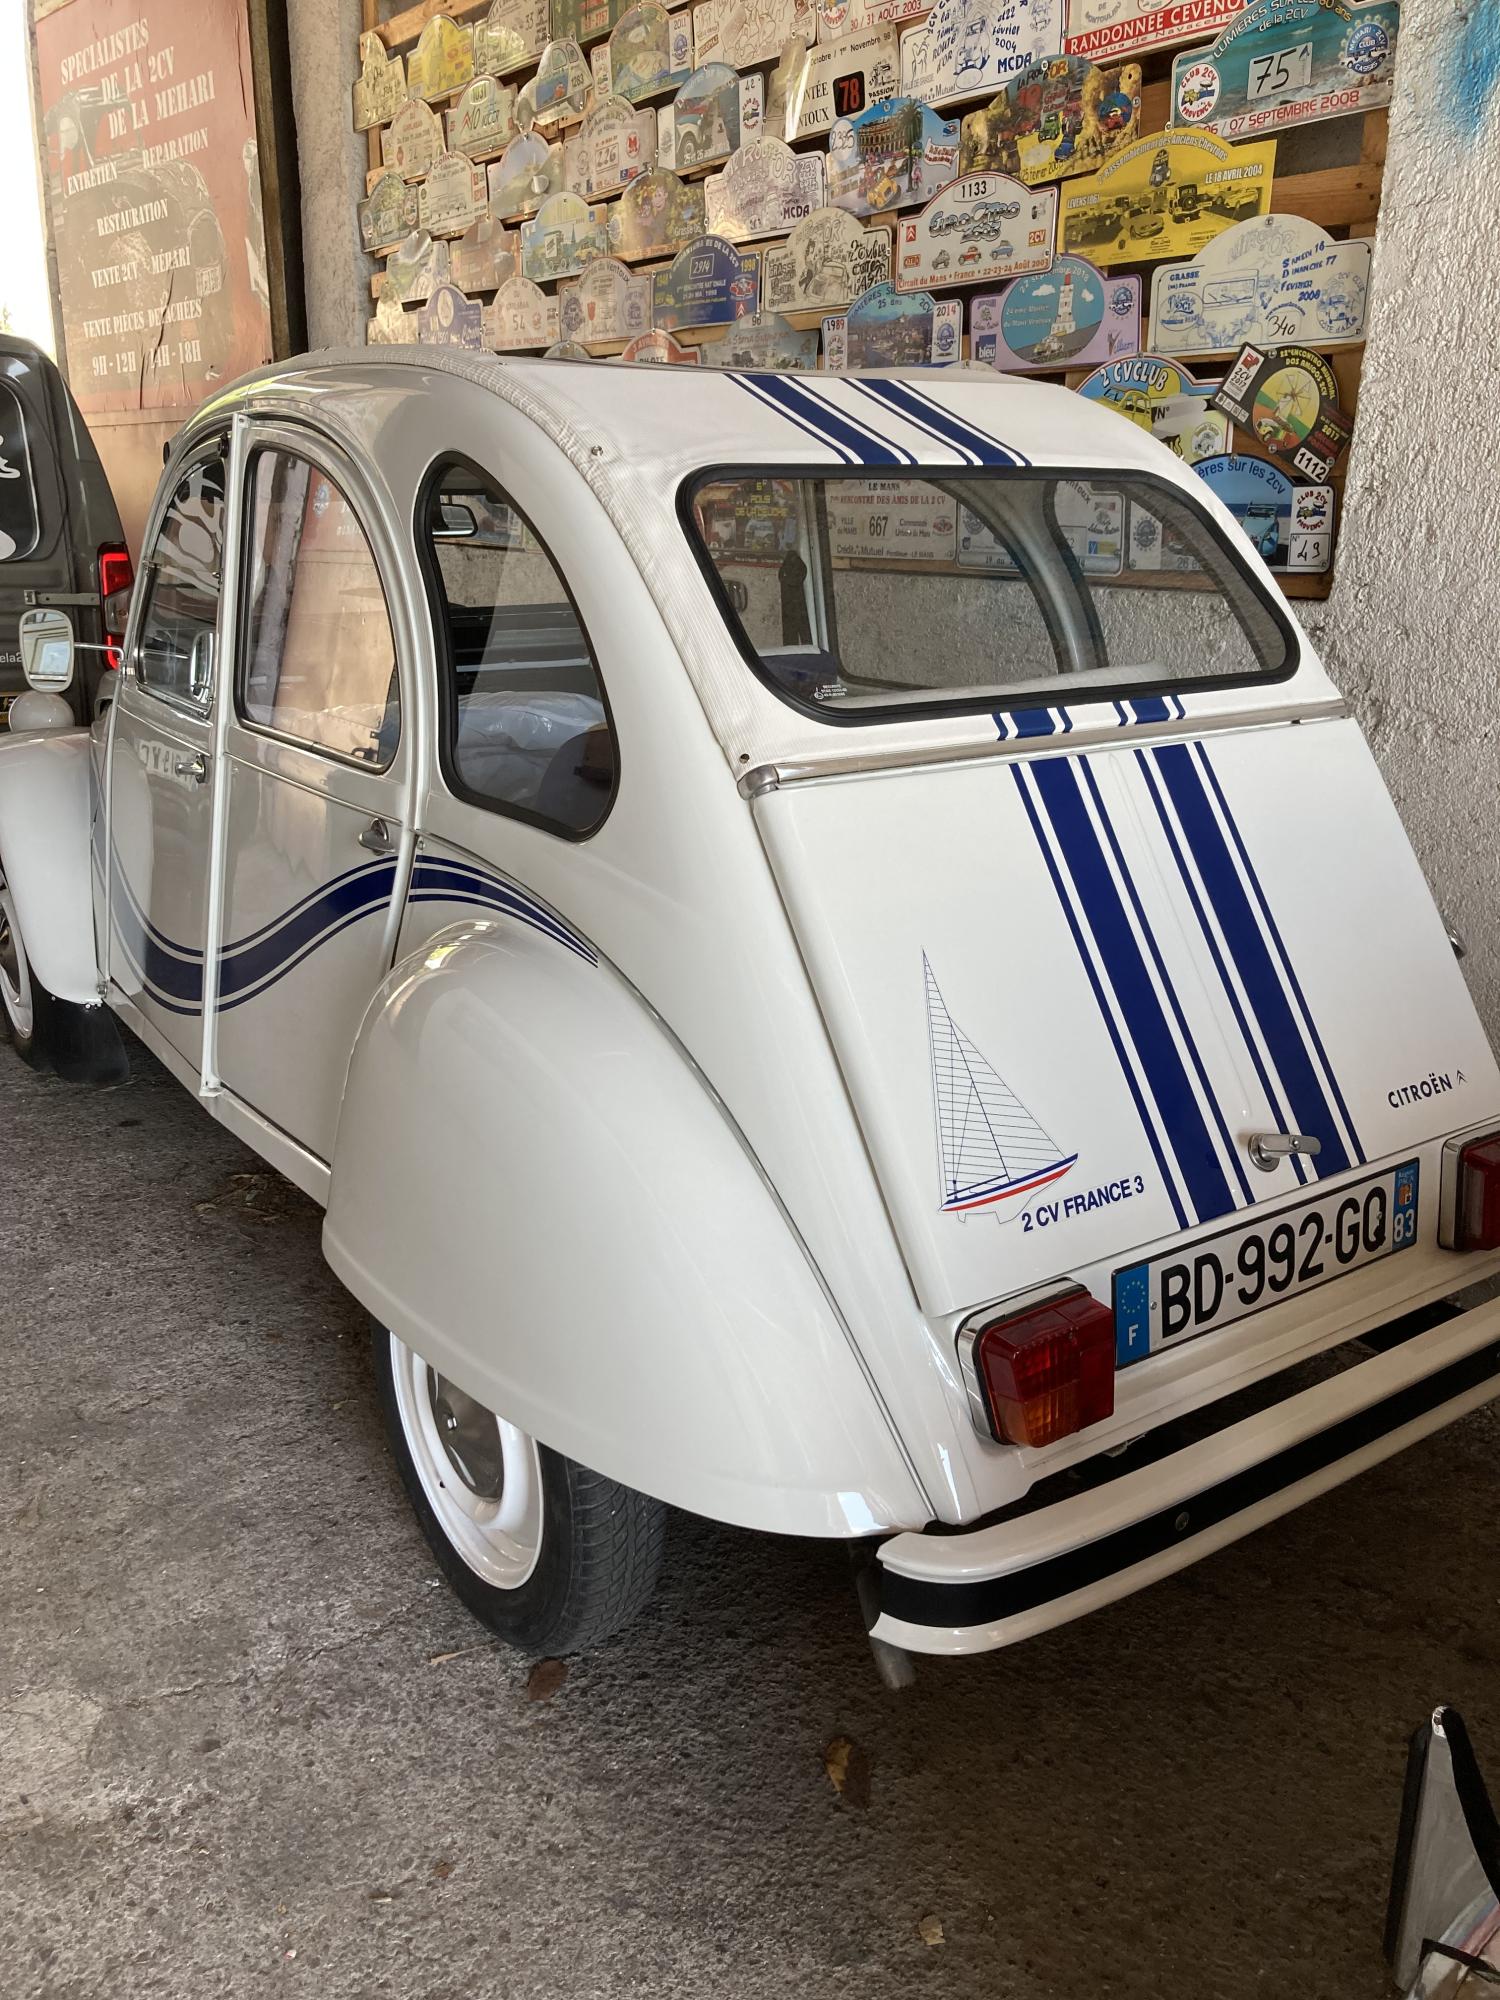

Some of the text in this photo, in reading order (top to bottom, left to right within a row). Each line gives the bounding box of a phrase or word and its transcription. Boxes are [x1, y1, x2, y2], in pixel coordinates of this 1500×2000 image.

[867, 14, 874, 25] 31
[878, 3, 899, 21] AOÛT
[903, 1, 921, 13] 2003
[1259, 8, 1310, 32] de la 2CV
[1070, 0, 1244, 54] RANDONNEE CEVENO
[1213, 8, 1268, 58] LUMIERES
[1335, 4, 1352, 22] ans
[60, 18, 149, 85] SPECIALISTES
[850, 35, 881, 52] Novembre
[995, 37, 1017, 53] 2004
[1358, 38, 1376, 48] CLUB
[997, 52, 1032, 74] MCDA
[101, 46, 174, 104] DE LA 2CV
[1181, 66, 1217, 88] CLUB 2CV
[839, 78, 860, 112] 78
[868, 85, 895, 98] PASSION
[109, 70, 215, 139] DE LA MEHARI
[1229, 117, 1246, 131] 07
[1248, 97, 1317, 126] SEPTEMBRE
[1320, 90, 1360, 109] 2008
[67, 127, 209, 196] ENTRETIEN REPARATION
[1205, 164, 1264, 184] LE 18 AVRIL 2004
[961, 180, 987, 199] 1133
[96, 198, 168, 236] RESTAURATION
[783, 204, 810, 220] MCDA
[1029, 230, 1046, 243] 2CV
[91, 265, 120, 288] VENTE
[121, 261, 138, 281] 2CV
[898, 277, 918, 289] Circuit
[919, 276, 928, 285] du
[930, 274, 947, 284] Mans
[954, 269, 976, 280] France
[1014, 259, 1031, 271] Août
[1170, 271, 1200, 282] GRASSE
[886, 286, 896, 295] SU
[936, 304, 956, 318] 2014
[83, 317, 112, 338] VENTE
[826, 319, 845, 331] 1989
[1268, 315, 1296, 338] 340
[979, 346, 996, 359] bleu
[1231, 375, 1247, 388] 2017
[1234, 367, 1251, 379] 2CV
[1296, 450, 1328, 480] 1112
[868, 481, 900, 491] LE MANS
[1199, 459, 1286, 495] ères sur les 2cv
[877, 495, 889, 505] DES
[891, 495, 909, 505] AMIS
[910, 495, 919, 505] DE
[920, 495, 929, 505] LA
[936, 495, 946, 505] CV
[1297, 490, 1328, 506] CLUB 2CV
[869, 515, 889, 537] 667
[0, 651, 22, 663] ela2
[1387, 1071, 1452, 1110] CITROËN
[1021, 1175, 1145, 1233] 2 CV FRANCE 3
[1128, 1184, 1415, 1347] F BD-992-GQ 83
